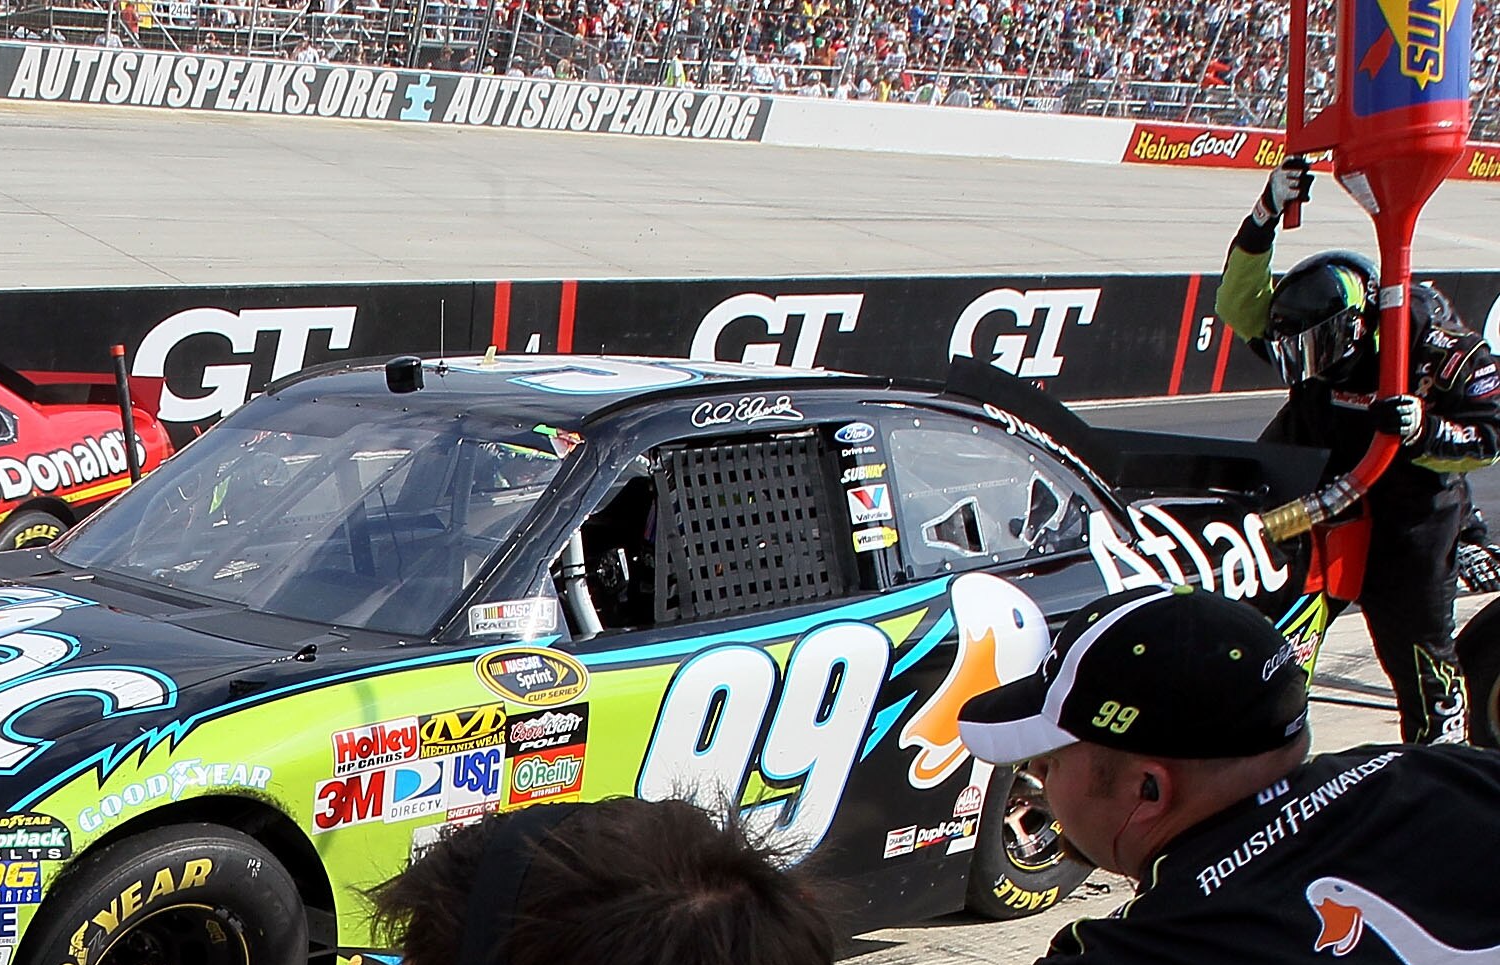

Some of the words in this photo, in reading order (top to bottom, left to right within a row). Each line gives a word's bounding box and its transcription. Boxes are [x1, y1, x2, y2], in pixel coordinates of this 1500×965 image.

[168, 3, 190, 18] 244
[7, 46, 398, 119] AUTISMSPEAKS.ORG
[443, 76, 761, 140] AUTISMSPEAKS.ORG
[690, 293, 864, 371] GT
[948, 288, 1100, 377] GT
[1197, 317, 1214, 351] 5
[133, 306, 358, 422] GT
[844, 427, 869, 440] Ford
[840, 463, 887, 484] SUBWAY
[14, 523, 61, 549] EAGLE
[1088, 503, 1289, 600] Aflac
[505, 655, 543, 674] NASCAR
[516, 668, 554, 690] Sprint
[528, 692, 547, 703] CUP
[548, 686, 579, 699] SERIES
[510, 720, 545, 742] Coors
[545, 714, 583, 736] LIGHT
[1092, 701, 1140, 734] 99
[336, 724, 417, 765] Holley
[421, 738, 475, 760] MECHANIX
[475, 729, 506, 749] WEAR
[518, 733, 571, 752] POLE
[637, 616, 892, 872] 99
[337, 762, 356, 775] HP
[357, 752, 403, 771] CARBS
[453, 750, 500, 796] USG
[516, 758, 580, 787] O'Reilly
[77, 757, 273, 833] GOODYEAR
[315, 772, 386, 829] 3M
[917, 818, 977, 843] Dupli-Color
